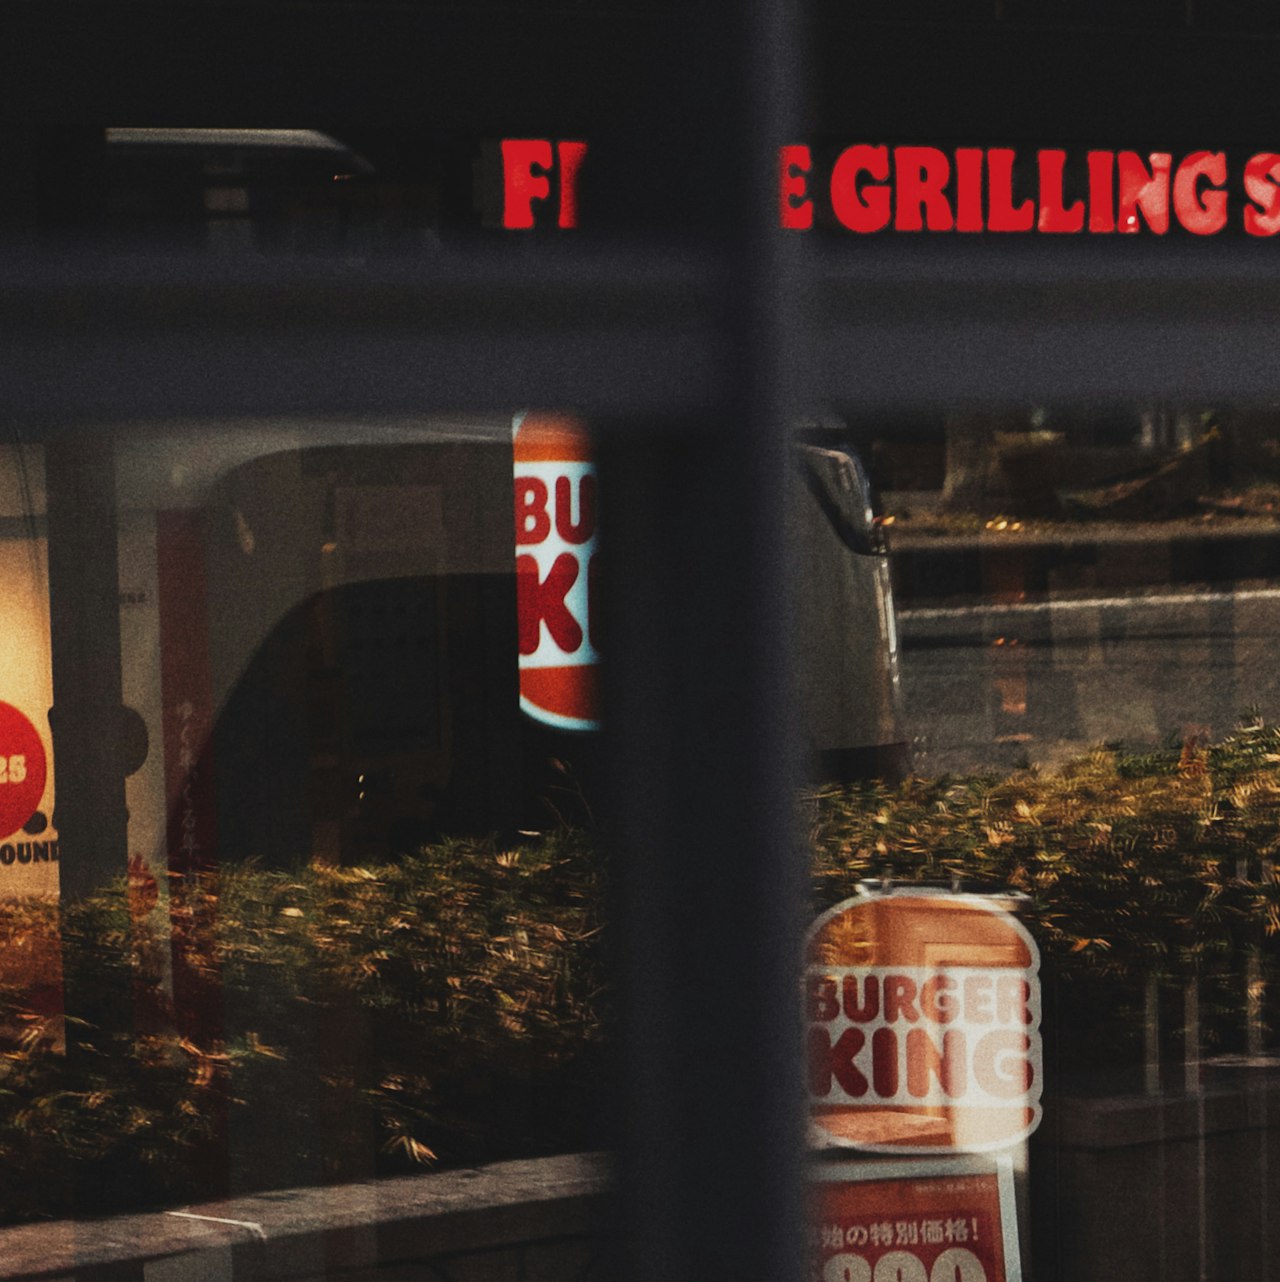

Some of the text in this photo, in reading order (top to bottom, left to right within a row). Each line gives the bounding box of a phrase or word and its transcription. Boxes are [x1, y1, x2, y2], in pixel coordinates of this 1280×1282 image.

[829, 143, 1229, 236] GRILLING
[806, 974, 1033, 1024] BURGER
[808, 1026, 1034, 1098] KING
